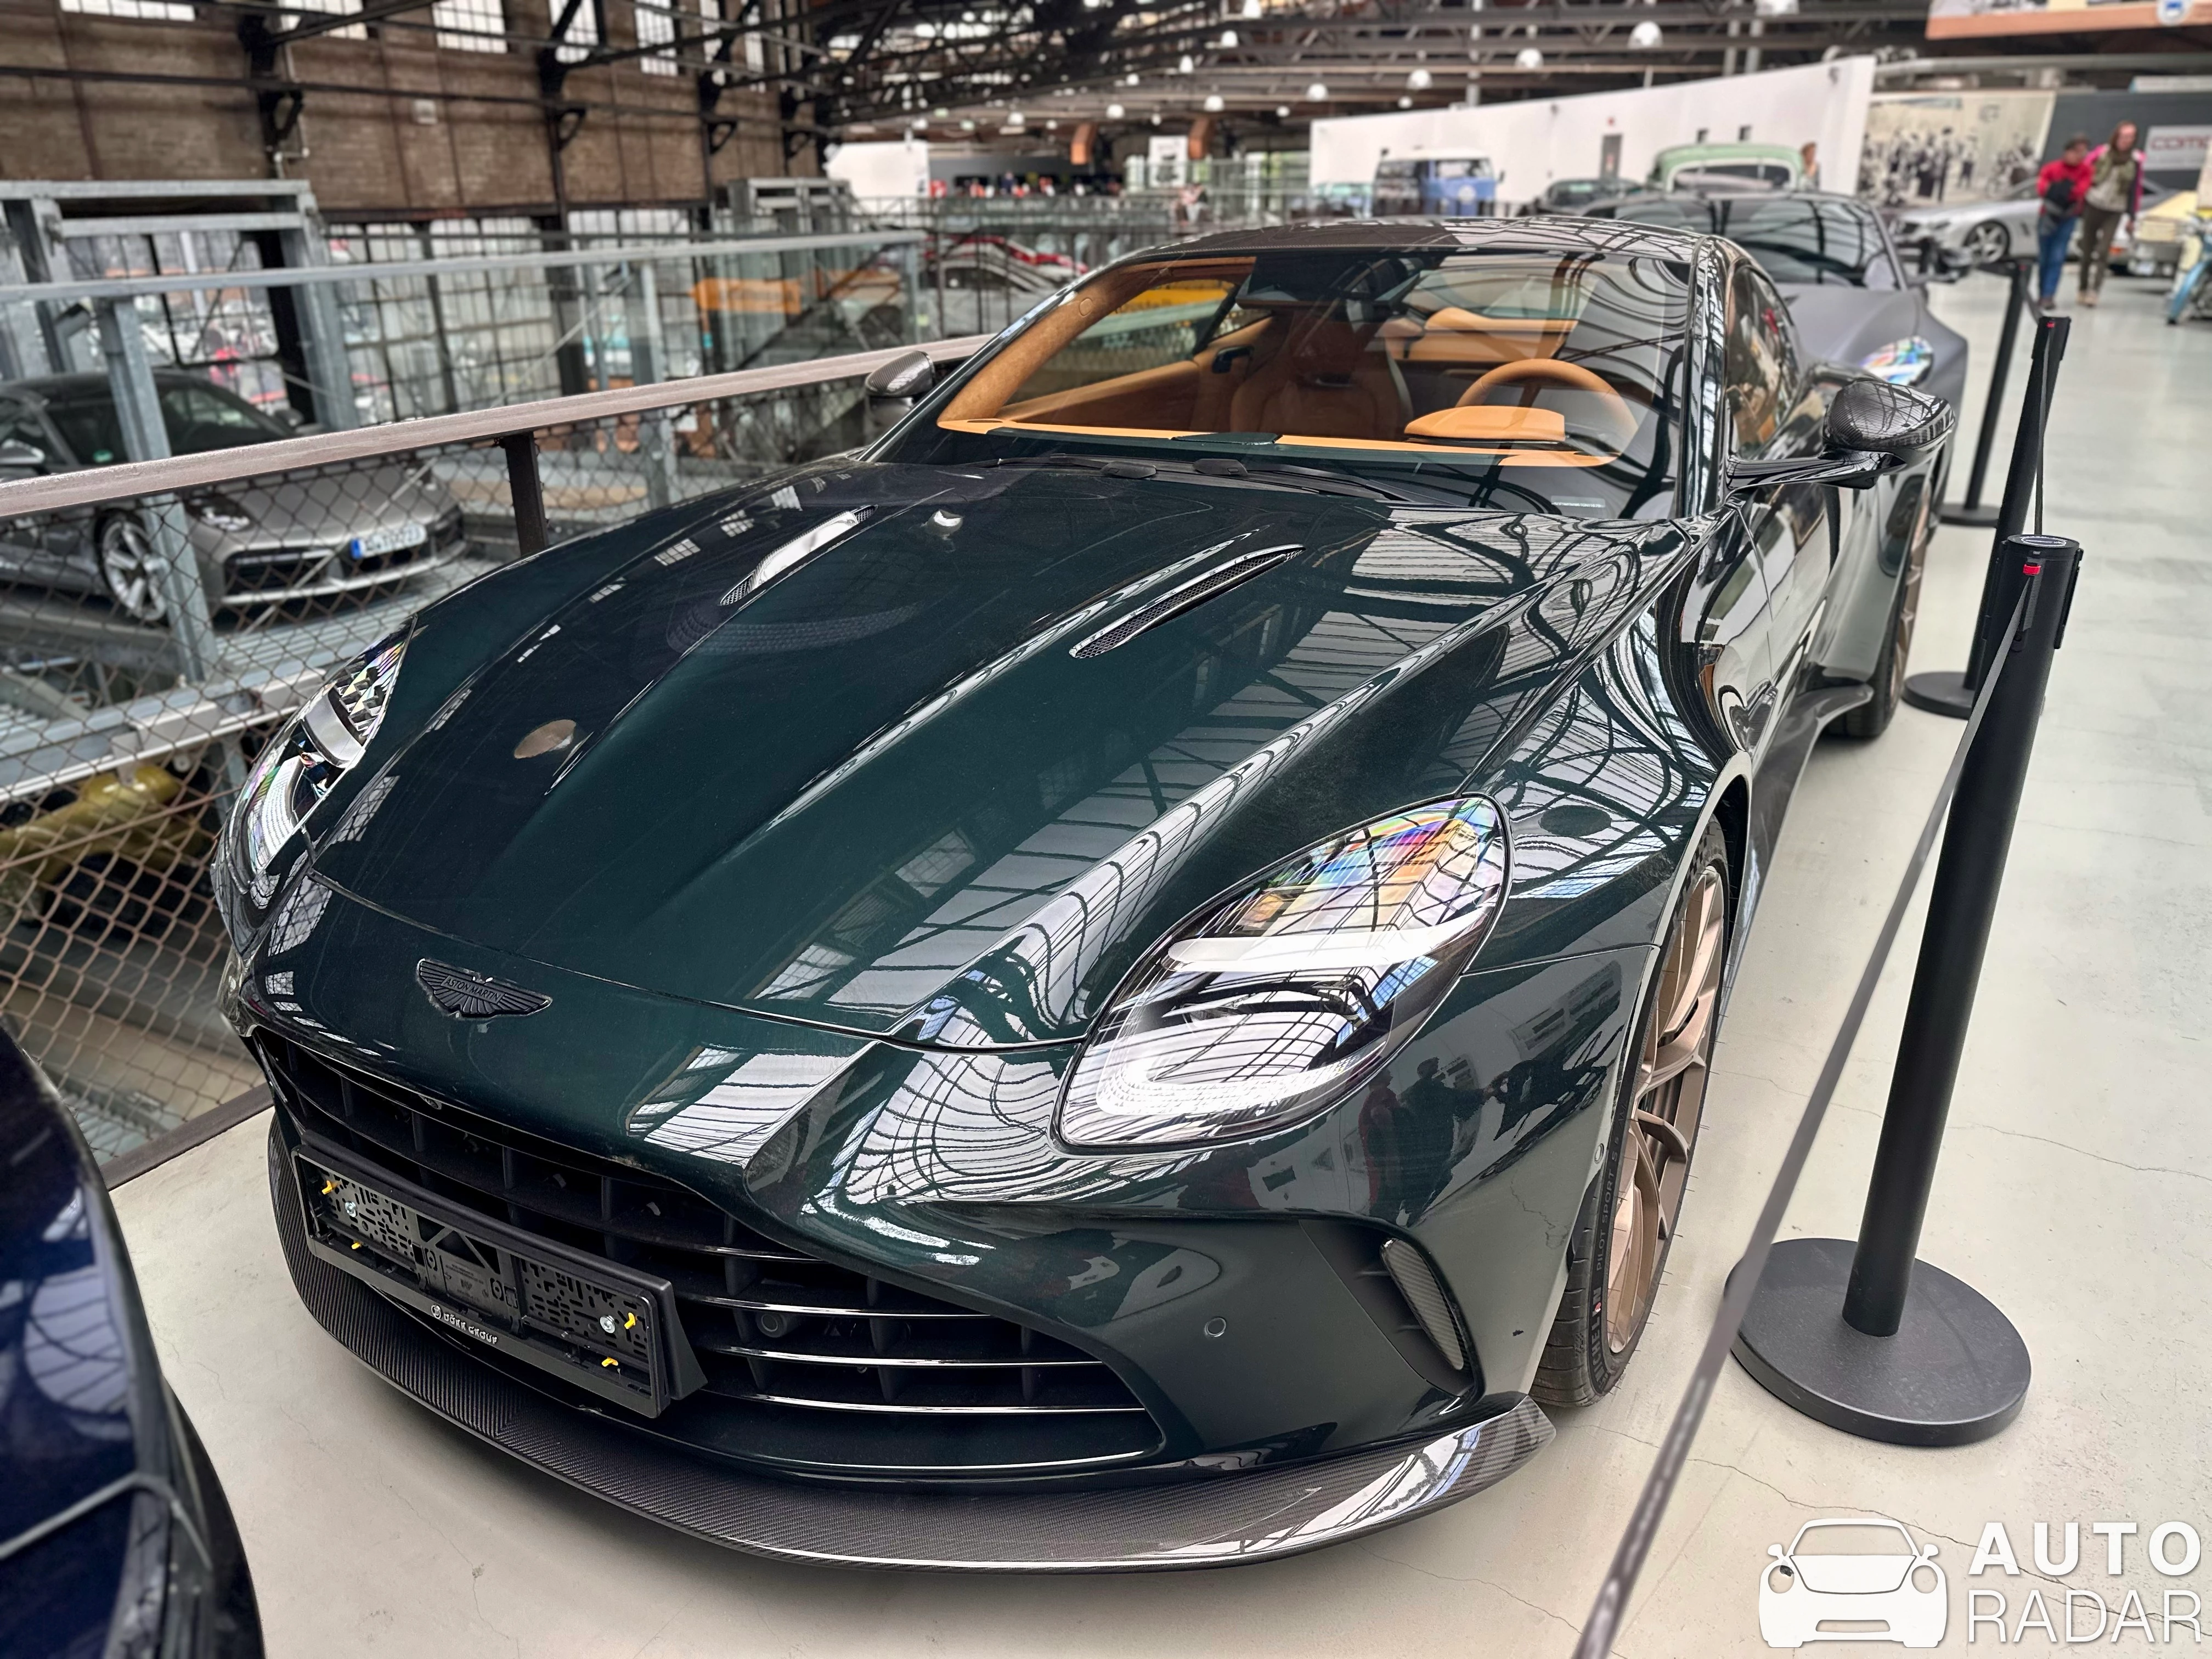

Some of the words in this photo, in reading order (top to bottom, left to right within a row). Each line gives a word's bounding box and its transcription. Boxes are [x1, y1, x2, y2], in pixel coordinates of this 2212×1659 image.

[445, 978, 472, 991] ASTON
[469, 986, 501, 1000] MARTIN
[1596, 1229, 1606, 1271] PILOT
[1602, 1169, 1615, 1223] SPORT
[468, 1326, 498, 1344] GROUP
